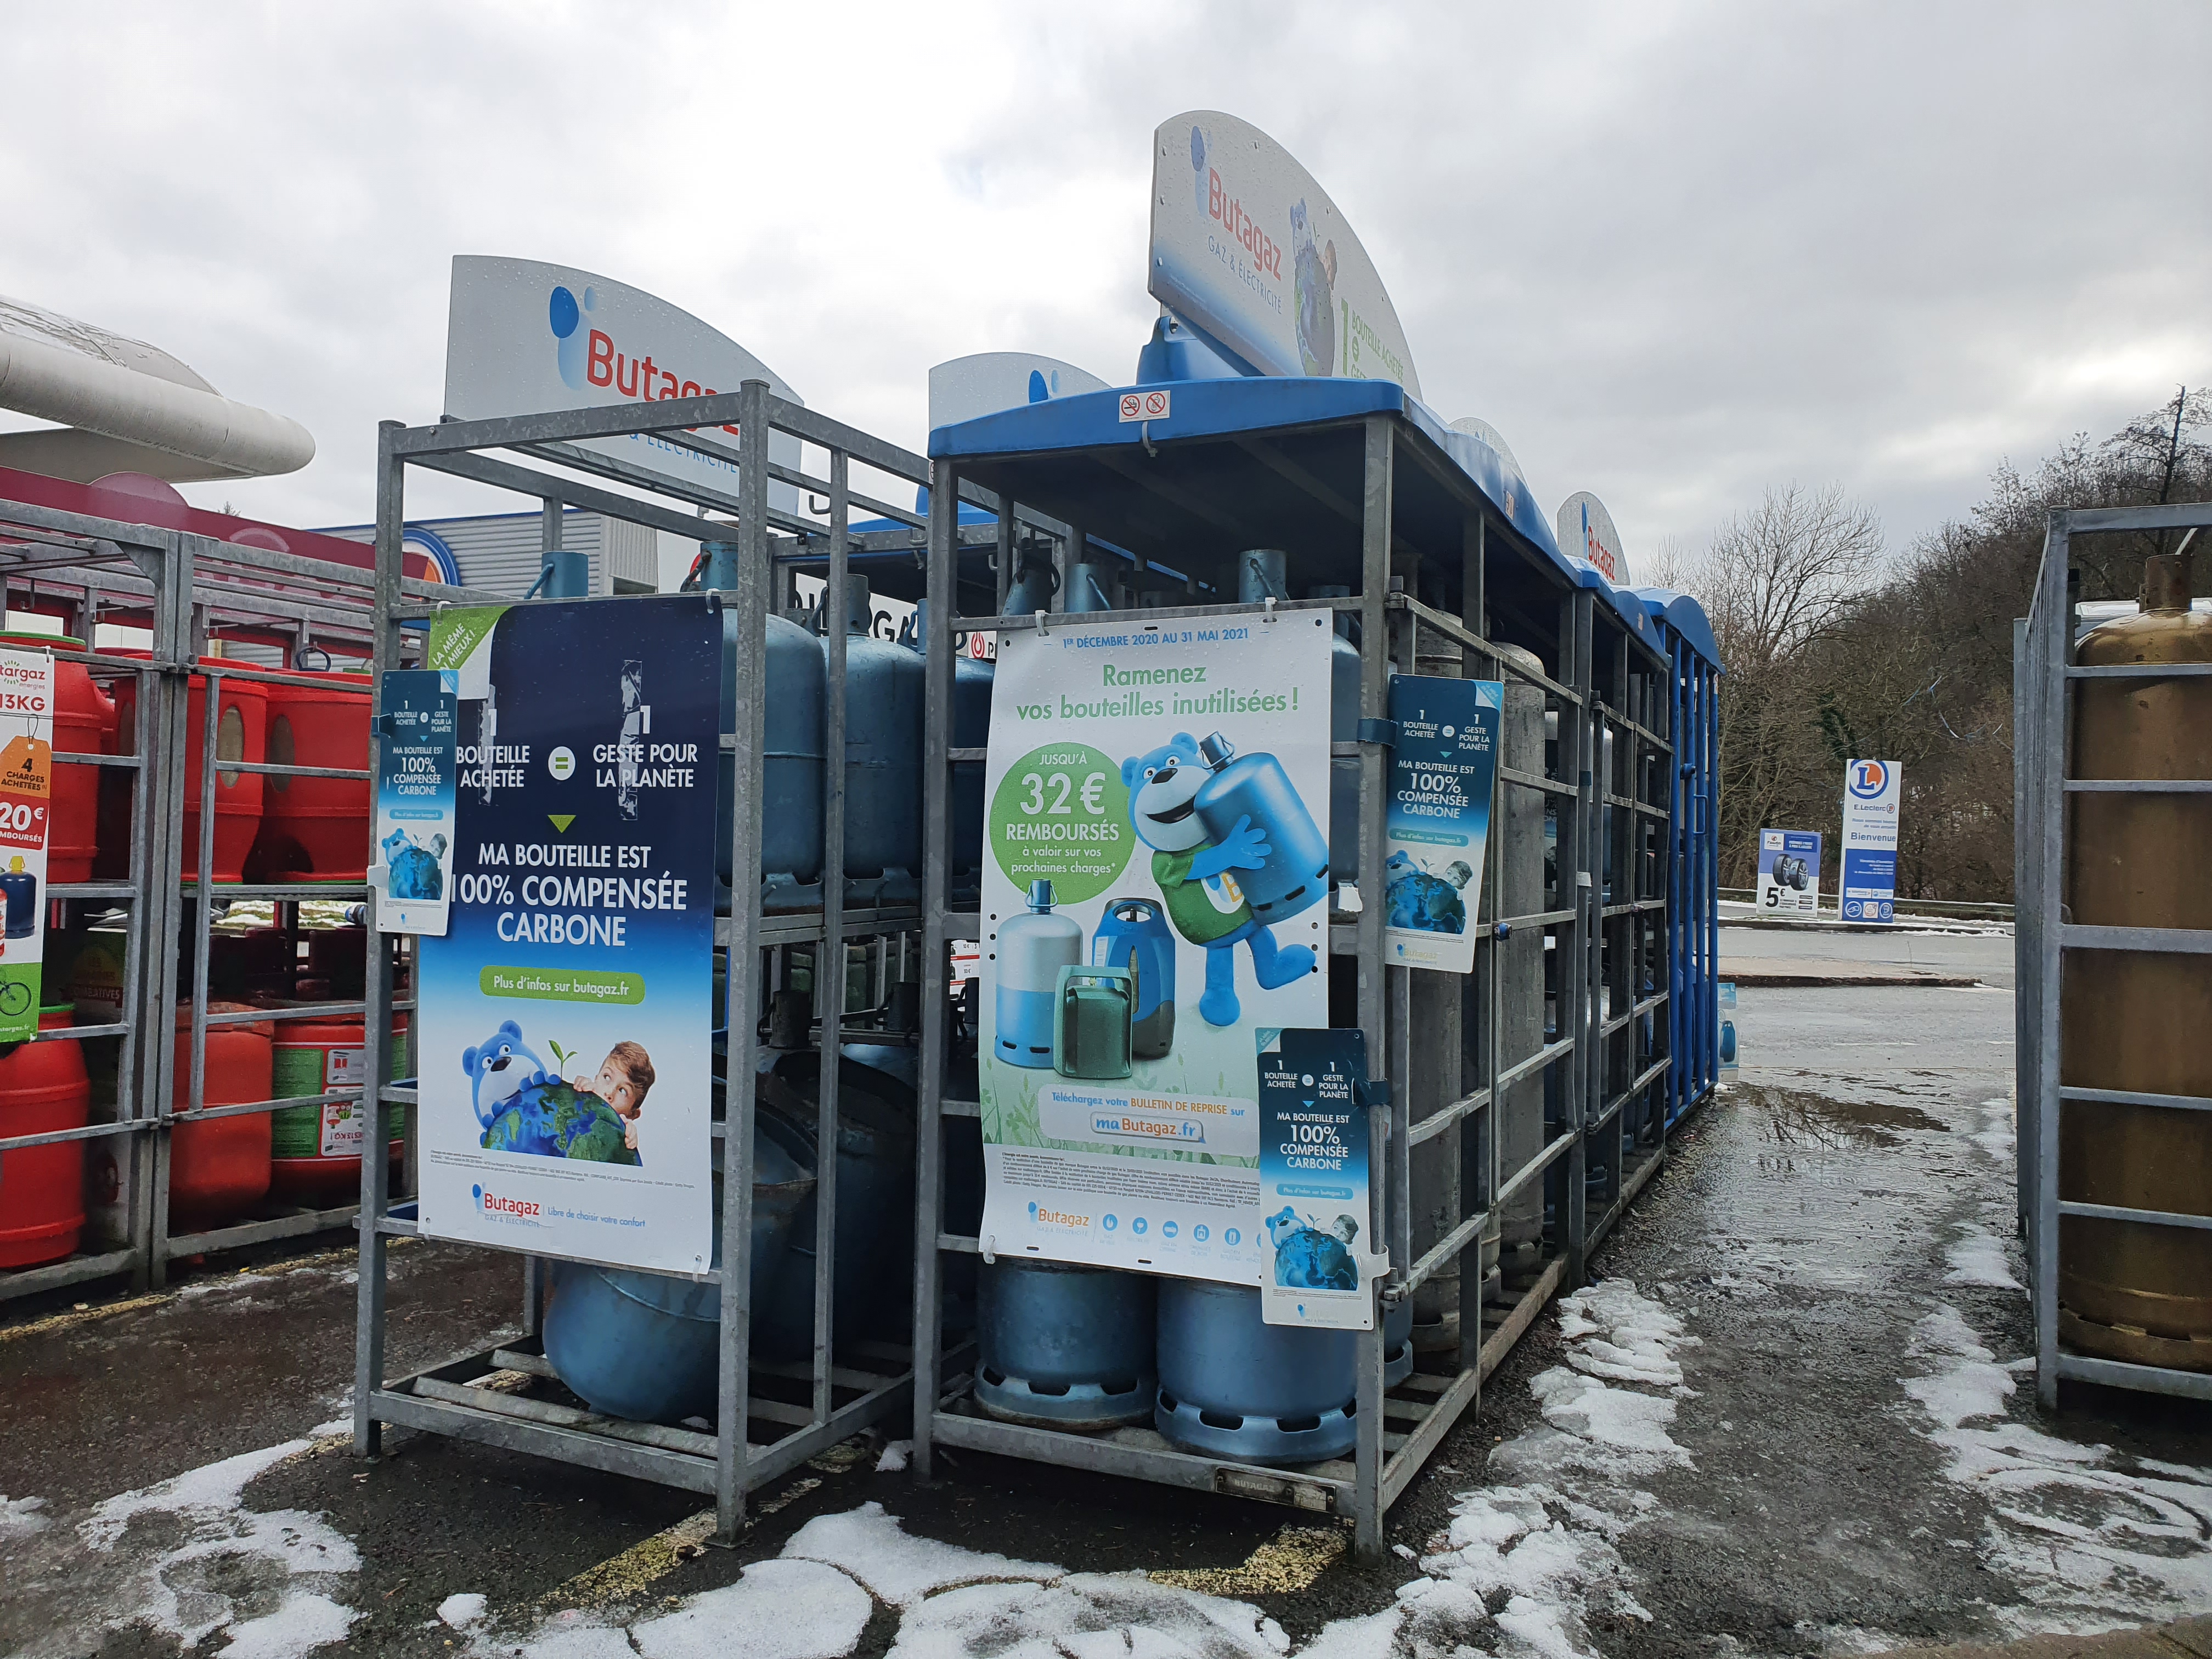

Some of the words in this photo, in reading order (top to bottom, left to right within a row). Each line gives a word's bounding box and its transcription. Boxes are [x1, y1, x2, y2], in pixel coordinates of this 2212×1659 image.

[1209, 167, 1281, 281] Butagaz
[1208, 235, 1226, 263] GAZ
[1229, 254, 1235, 273] &
[1238, 258, 1282, 314] ÉLECTRICITÉ
[1352, 309, 1380, 357] BOUTEILLE
[1381, 343, 1403, 383] ACHETÉE
[1588, 525, 1615, 582] Butagaz
[433, 652, 445, 665] LA
[442, 622, 466, 653] MÊME
[1077, 635, 1128, 648] DÉCEMBRE
[1132, 634, 1159, 646] 2020
[1162, 633, 1178, 644] AU
[1181, 631, 1193, 642] 31
[1197, 630, 1218, 641] MAI
[1222, 628, 1249, 640] 2021
[448, 632, 472, 665] MIEUX
[1103, 664, 1207, 687] Ramenez
[404, 700, 408, 709] 1
[439, 699, 444, 709] 1
[1016, 703, 1053, 720] vos
[1060, 691, 1164, 719] bouteilles
[488, 708, 498, 736] 1
[640, 705, 651, 734] 1
[1419, 709, 1425, 720] 1
[1474, 714, 1480, 724] 1
[1403, 721, 1438, 730] BOUTEILLE
[1404, 729, 1435, 738] ACHETÉE
[1464, 726, 1487, 735] GESTE
[1458, 742, 1489, 752] PLANÈTE
[1481, 735, 1490, 743] LA
[456, 745, 530, 764] BOUTEILLE
[593, 743, 644, 763] GESTE
[650, 743, 698, 763] POUR
[1039, 751, 1087, 765] JUSQU'À
[21, 758, 33, 772] 4
[402, 757, 436, 773] 100%
[1398, 760, 1413, 769] MA
[1415, 761, 1458, 773] BOUTEILLE
[1460, 765, 1475, 774] EST
[7, 771, 44, 783] CHARGES
[393, 772, 442, 784] COMPENSÉE
[460, 764, 524, 787] ACHETÉE
[596, 769, 617, 787] LA
[622, 763, 695, 787] PLANÈTE
[1410, 772, 1461, 794] 100%
[398, 785, 437, 795] CARBONE
[1397, 790, 1469, 807] COMPENSÉE
[1403, 803, 1461, 819] CARBONE
[1006, 819, 1120, 841] REMBOURSÉS
[1851, 832, 1896, 842] Bienvenue
[478, 843, 510, 865] MA
[516, 844, 611, 867] BOUTEILLE
[618, 845, 652, 868] EST
[1022, 845, 1029, 856] à
[1032, 844, 1062, 856] valoir
[1065, 848, 1081, 856] sur
[1084, 848, 1102, 857] vos
[1011, 860, 1067, 876] prochaines
[451, 873, 515, 905] 100%
[522, 870, 687, 910] COMPENSÉE
[496, 911, 627, 946] CARBONE
[494, 974, 514, 989] Plus
[516, 975, 551, 991] d'infos
[554, 981, 571, 992] sur
[573, 978, 629, 998] butagaz.fr
[1277, 1059, 1283, 1070] 1
[1329, 1061, 1335, 1072] 1
[1264, 1072, 1298, 1080] BOUTEILLE
[1267, 1080, 1296, 1088] ACHETÉE
[1318, 1082, 1338, 1090] POUR
[1319, 1090, 1348, 1099] PLANÈTE
[1052, 1092, 1103, 1107] Téléchargez
[1105, 1098, 1128, 1107] votre
[1131, 1098, 1172, 1110] BULLETIN
[1175, 1101, 1187, 1112] DE
[1190, 1103, 1228, 1115] REPRISE
[1231, 1108, 1245, 1117] sur
[1277, 1111, 1291, 1121] MA
[1293, 1113, 1333, 1122] BOUTEILLE
[1335, 1115, 1350, 1124] EST
[1290, 1124, 1340, 1144] 100%
[1280, 1143, 1348, 1158] COMPENSÉE
[1286, 1156, 1342, 1171] CARBONE
[484, 1193, 540, 1217] Butagaz
[548, 1206, 565, 1217] Libre
[566, 1209, 575, 1218] de
[576, 1210, 599, 1222] choisir
[600, 1215, 618, 1224] votre
[619, 1216, 646, 1227] confort
[1038, 1208, 1090, 1227] Butagaz
